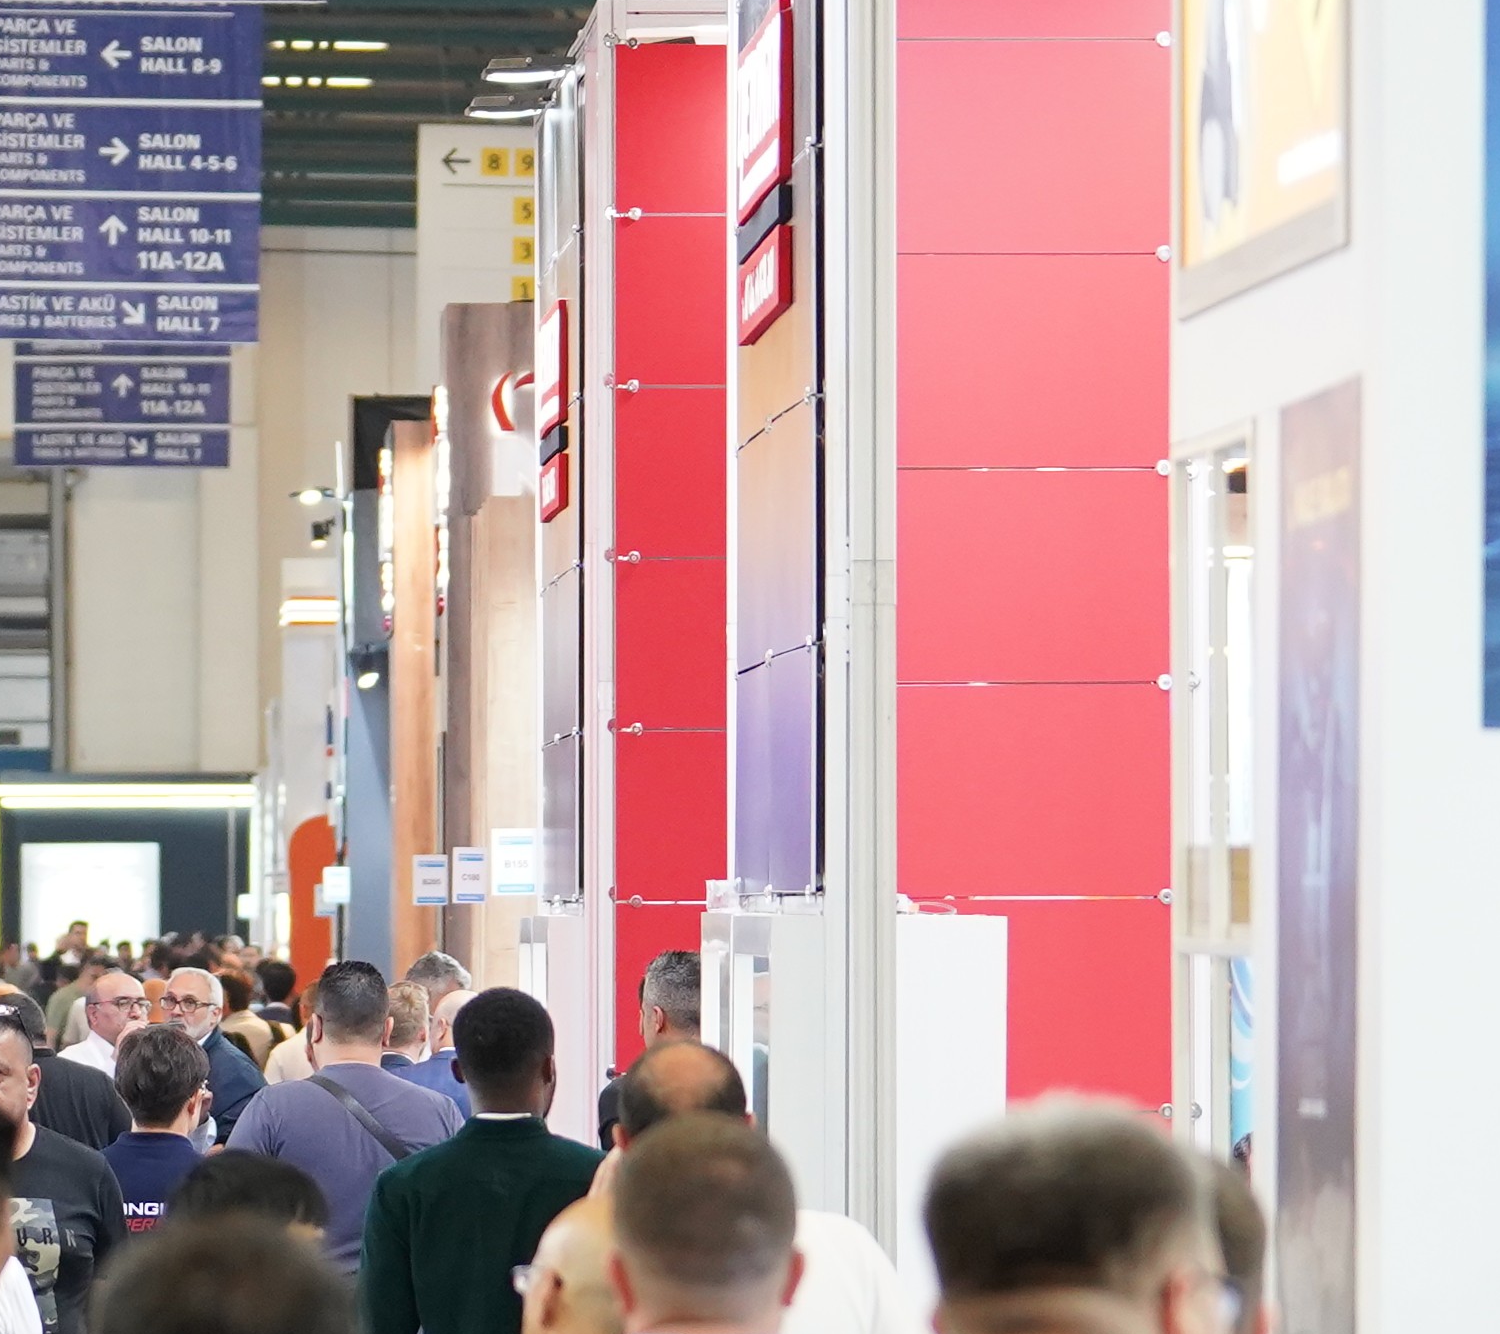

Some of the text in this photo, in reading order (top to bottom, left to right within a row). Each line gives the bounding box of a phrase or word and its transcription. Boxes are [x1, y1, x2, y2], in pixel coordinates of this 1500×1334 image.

[54, 19, 76, 35] VE
[141, 37, 202, 52] SALON
[141, 58, 222, 74] HALL 8-9
[53, 114, 74, 128] VE
[139, 133, 200, 150] SALON
[139, 155, 237, 171] HALL 4-5-6
[489, 154, 500, 170] 8
[51, 206, 73, 221] VE
[138, 207, 199, 223] SALON
[138, 228, 231, 244] HALL 10-11
[137, 251, 224, 271] 11A-12A
[52, 296, 74, 311] VE
[157, 296, 218, 311] SALON
[157, 316, 220, 332] HALL 7
